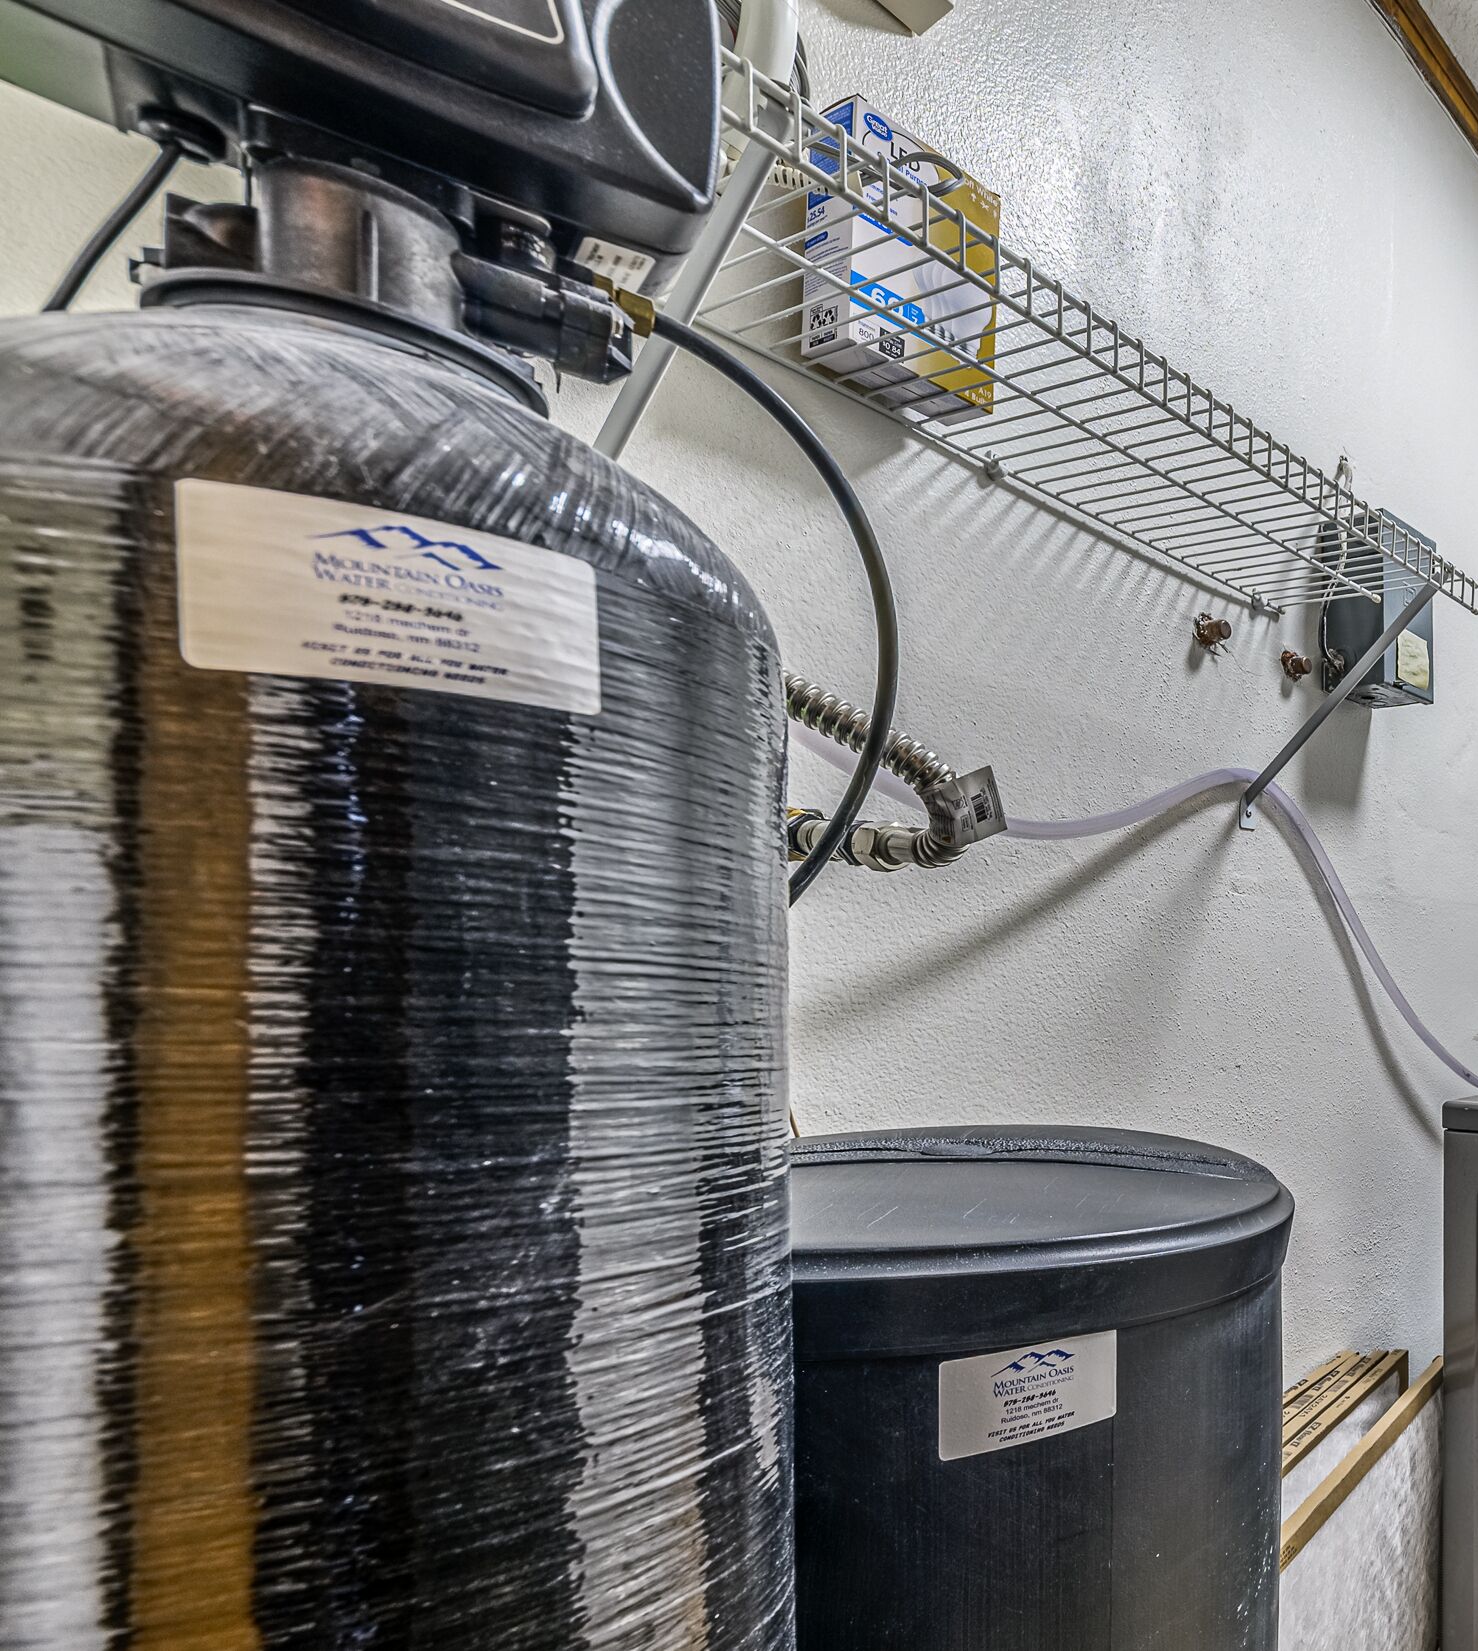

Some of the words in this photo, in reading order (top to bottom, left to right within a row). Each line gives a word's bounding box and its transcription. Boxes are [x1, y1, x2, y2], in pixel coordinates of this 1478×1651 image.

[444, 573, 504, 597] OASIS
[994, 1385, 1026, 1398] WATER
[1028, 1375, 1074, 1391] CONDITIONING
[995, 1372, 1047, 1391] MOUNTAIN
[1049, 1365, 1074, 1378] OASIS
[1006, 1405, 1022, 1415] 1218
[1024, 1400, 1051, 1411] mechem
[1053, 1396, 1060, 1404] dr
[1032, 1409, 1042, 1417] nm
[1044, 1403, 1063, 1414] 88312
[988, 1428, 1007, 1438] VISIT
[1009, 1426, 1017, 1434] US
[1019, 1423, 1030, 1431] FOR
[1032, 1420, 1043, 1428] ALL
[1057, 1410, 1075, 1421] WATER
[1000, 1426, 1045, 1443] CONDITIONING
[1047, 1421, 1065, 1431] NEEDS
